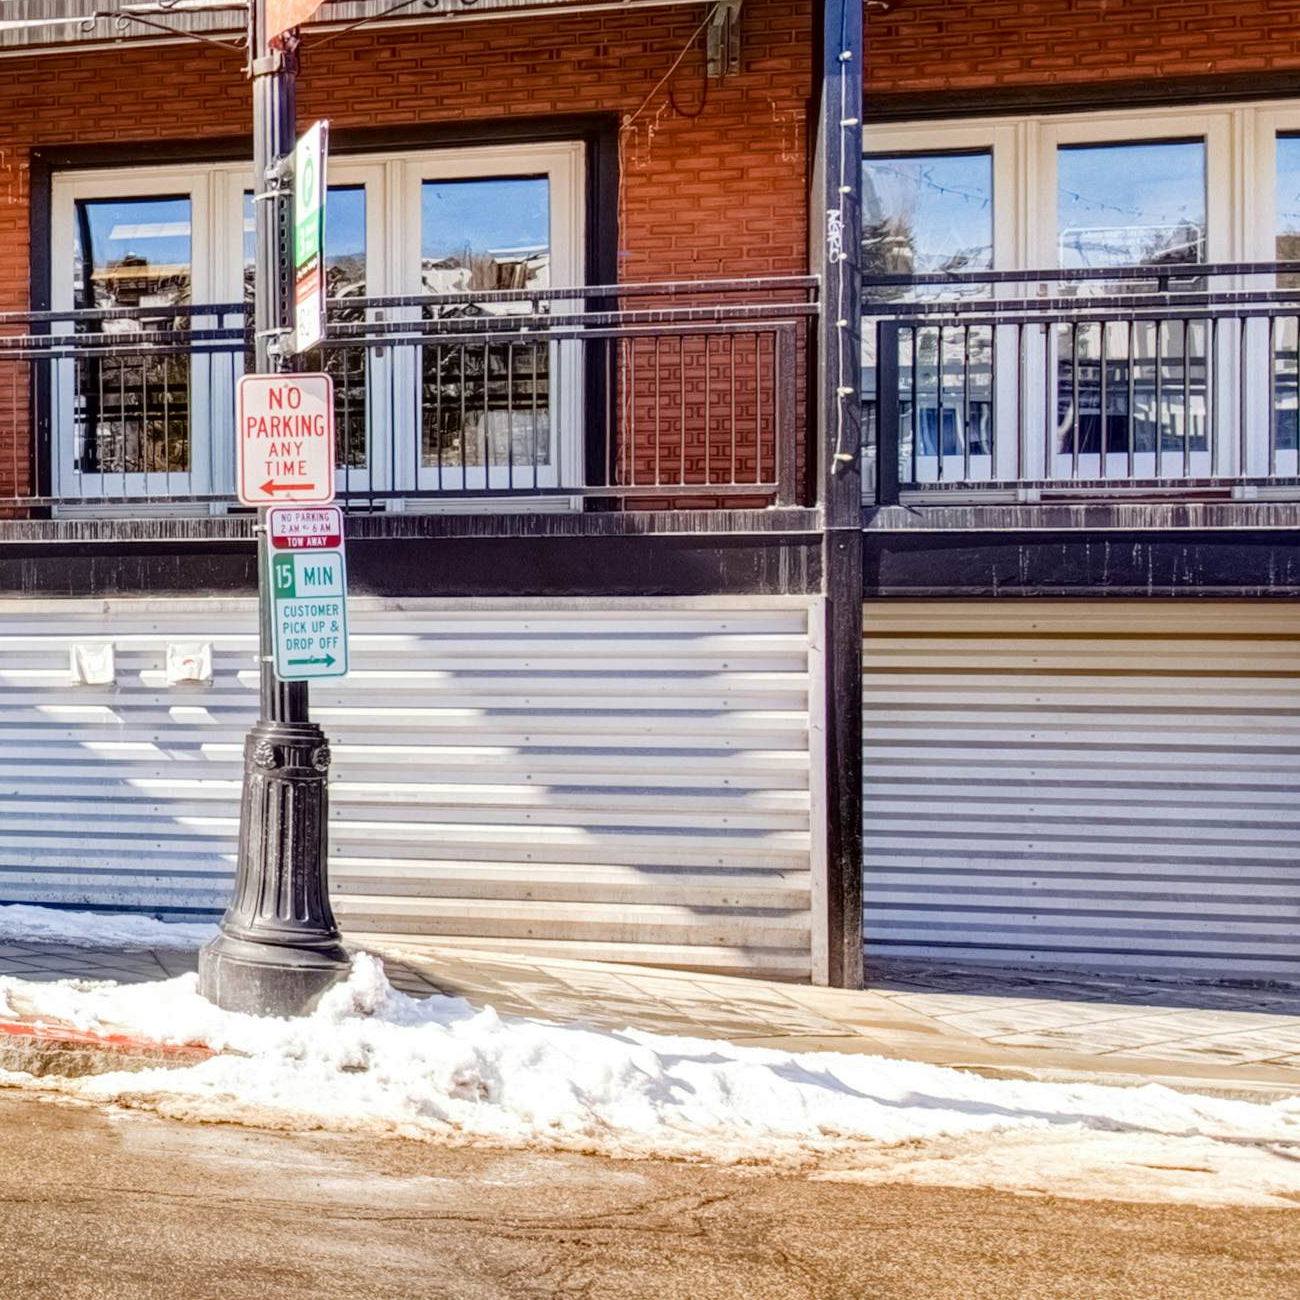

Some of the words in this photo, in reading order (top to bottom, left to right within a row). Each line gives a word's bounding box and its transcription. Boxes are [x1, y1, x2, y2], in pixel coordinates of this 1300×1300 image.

[268, 387, 302, 410] NO
[246, 414, 325, 438] PARKING
[268, 441, 304, 458] ANY
[265, 460, 307, 476] TIME
[281, 513, 292, 522] NO
[295, 512, 330, 522] PARKING
[280, 525, 286, 534] 2
[288, 524, 300, 534] AM
[320, 523, 331, 532] AM
[287, 537, 303, 547] TOW
[306, 536, 328, 547] AWAY
[275, 564, 292, 589] 15
[303, 566, 333, 586] MIN
[283, 604, 339, 618] CUSTOMER
[283, 622, 307, 634] PICK
[312, 622, 325, 633] UP
[330, 620, 339, 633] &
[286, 638, 314, 651] DROP
[319, 636, 339, 649] OFF
